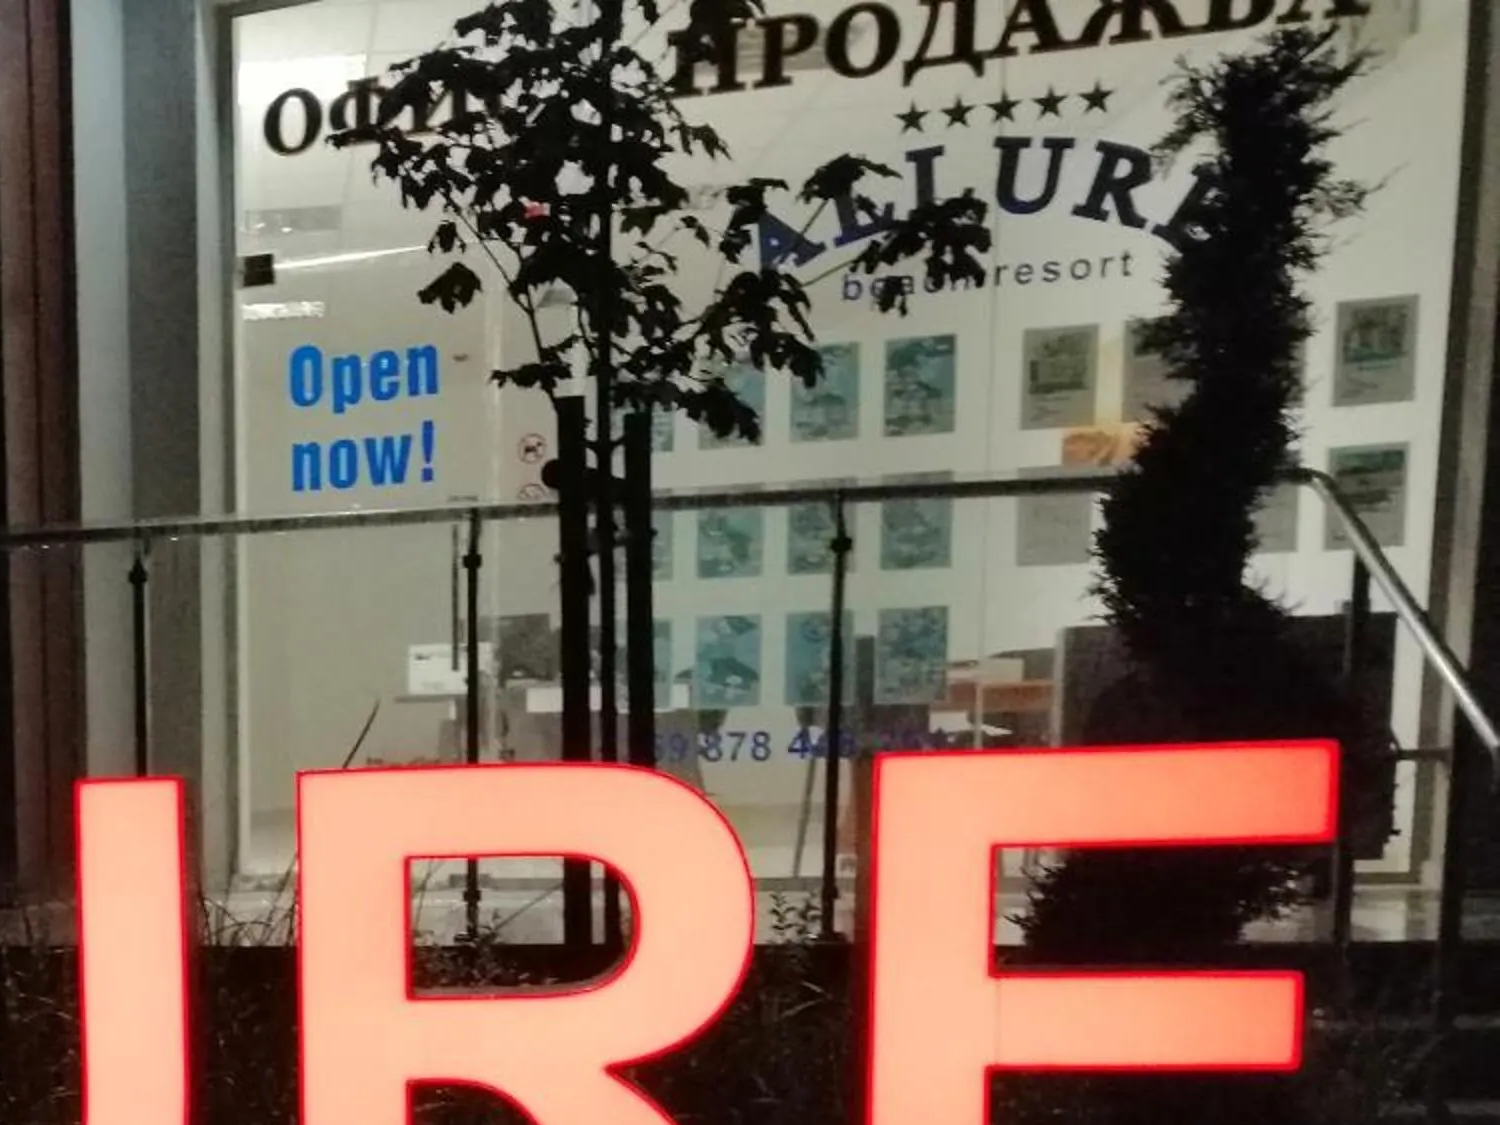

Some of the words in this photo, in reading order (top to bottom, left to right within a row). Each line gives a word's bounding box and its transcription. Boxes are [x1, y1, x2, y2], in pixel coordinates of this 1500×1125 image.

[994, 250, 1133, 287] resort
[290, 345, 438, 414] Open
[292, 419, 434, 491] now!
[700, 731, 771, 762] 878
